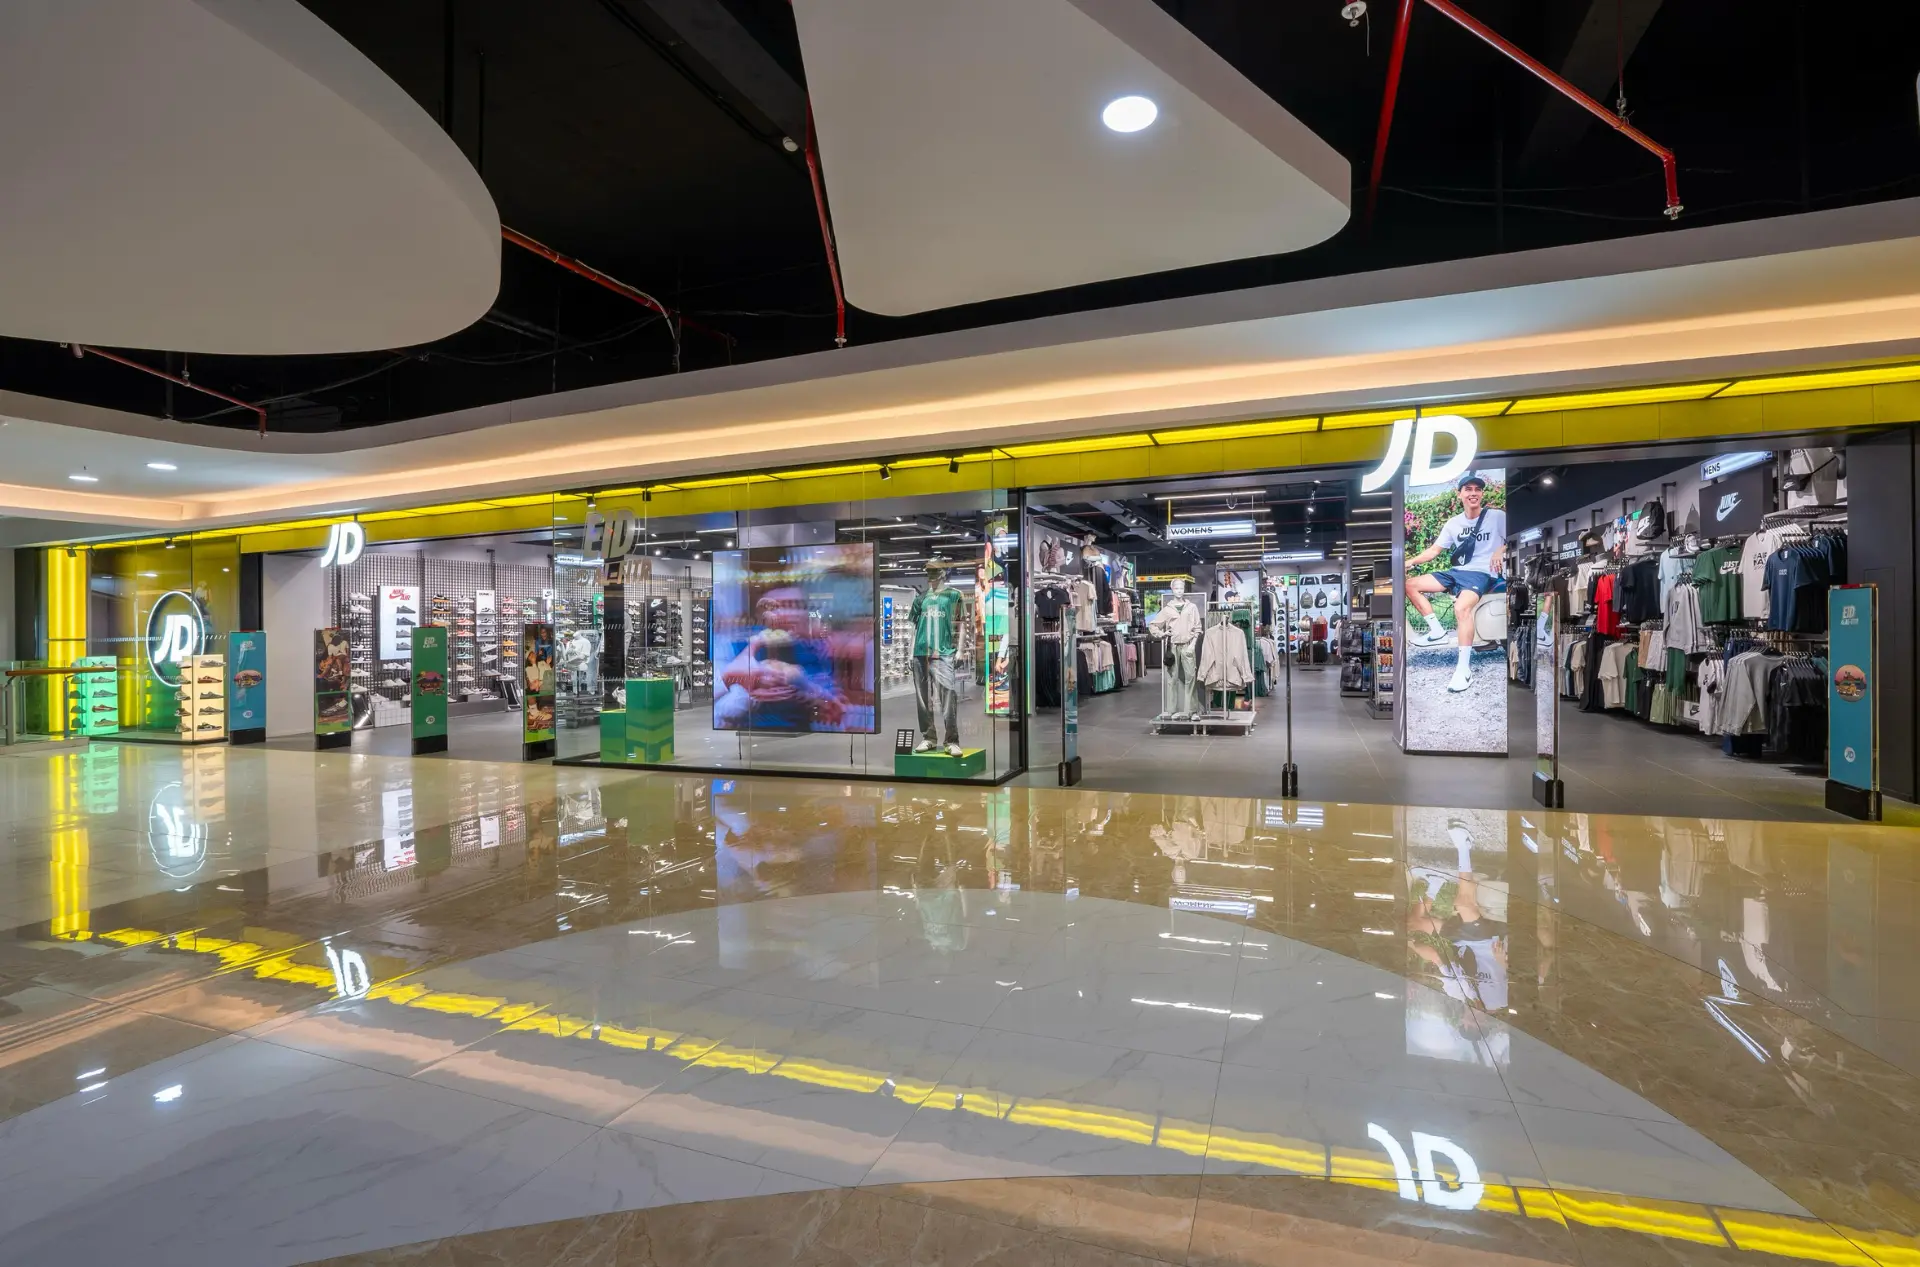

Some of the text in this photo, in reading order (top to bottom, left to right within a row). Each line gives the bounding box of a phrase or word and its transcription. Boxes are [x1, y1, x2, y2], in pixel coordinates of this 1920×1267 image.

[1361, 415, 1477, 493] JD
[1704, 463, 1721, 476] MENS
[1720, 492, 1738, 509] NIKE
[321, 522, 363, 567] JD
[583, 509, 636, 559] EID
[1171, 527, 1213, 535] WOMENS
[154, 614, 197, 664] JD
